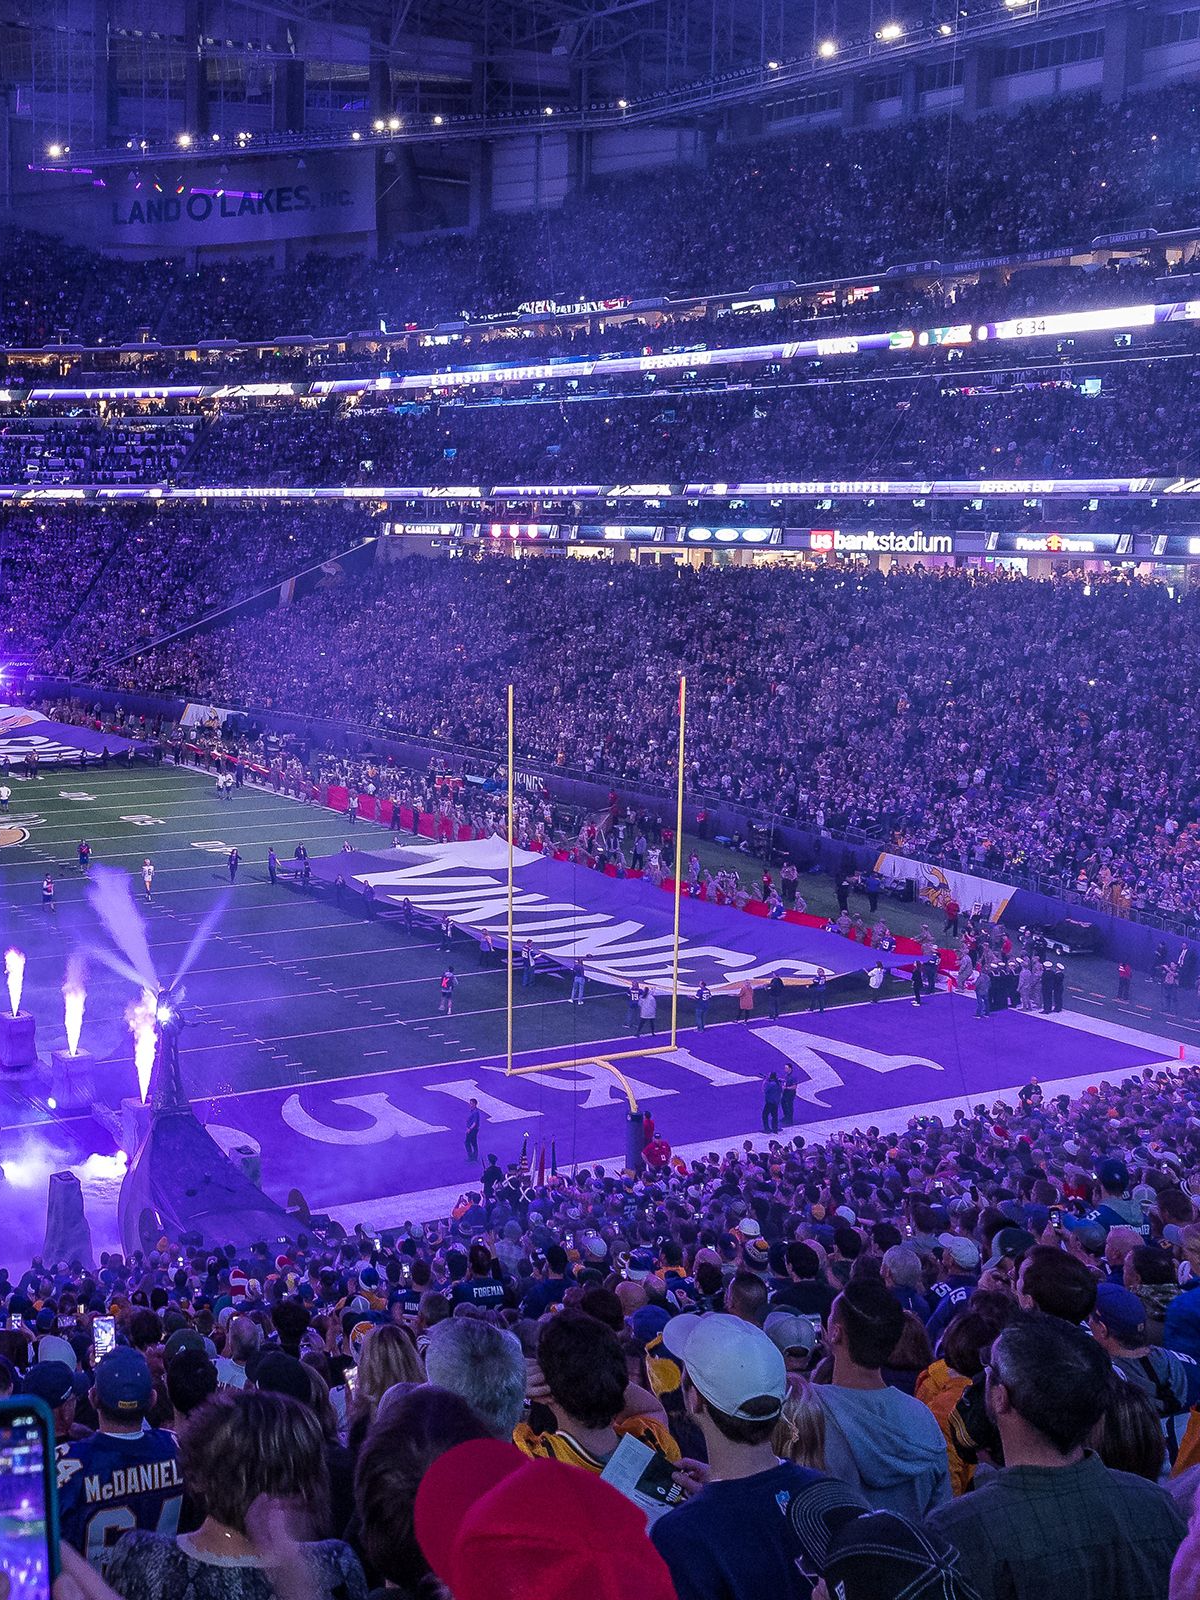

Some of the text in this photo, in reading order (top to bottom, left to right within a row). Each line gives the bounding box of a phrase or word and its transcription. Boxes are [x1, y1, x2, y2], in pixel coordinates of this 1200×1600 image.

[112, 198, 182, 226] LAND
[954, 257, 1010, 272] MINNESOTA VIKINGS
[431, 371, 490, 386] EVERSON
[514, 771, 544, 791] IKINGS
[473, 1286, 505, 1298] FOREMAN
[404, 1301, 419, 1311] HUN
[84, 1459, 184, 1503] McDANIEL
